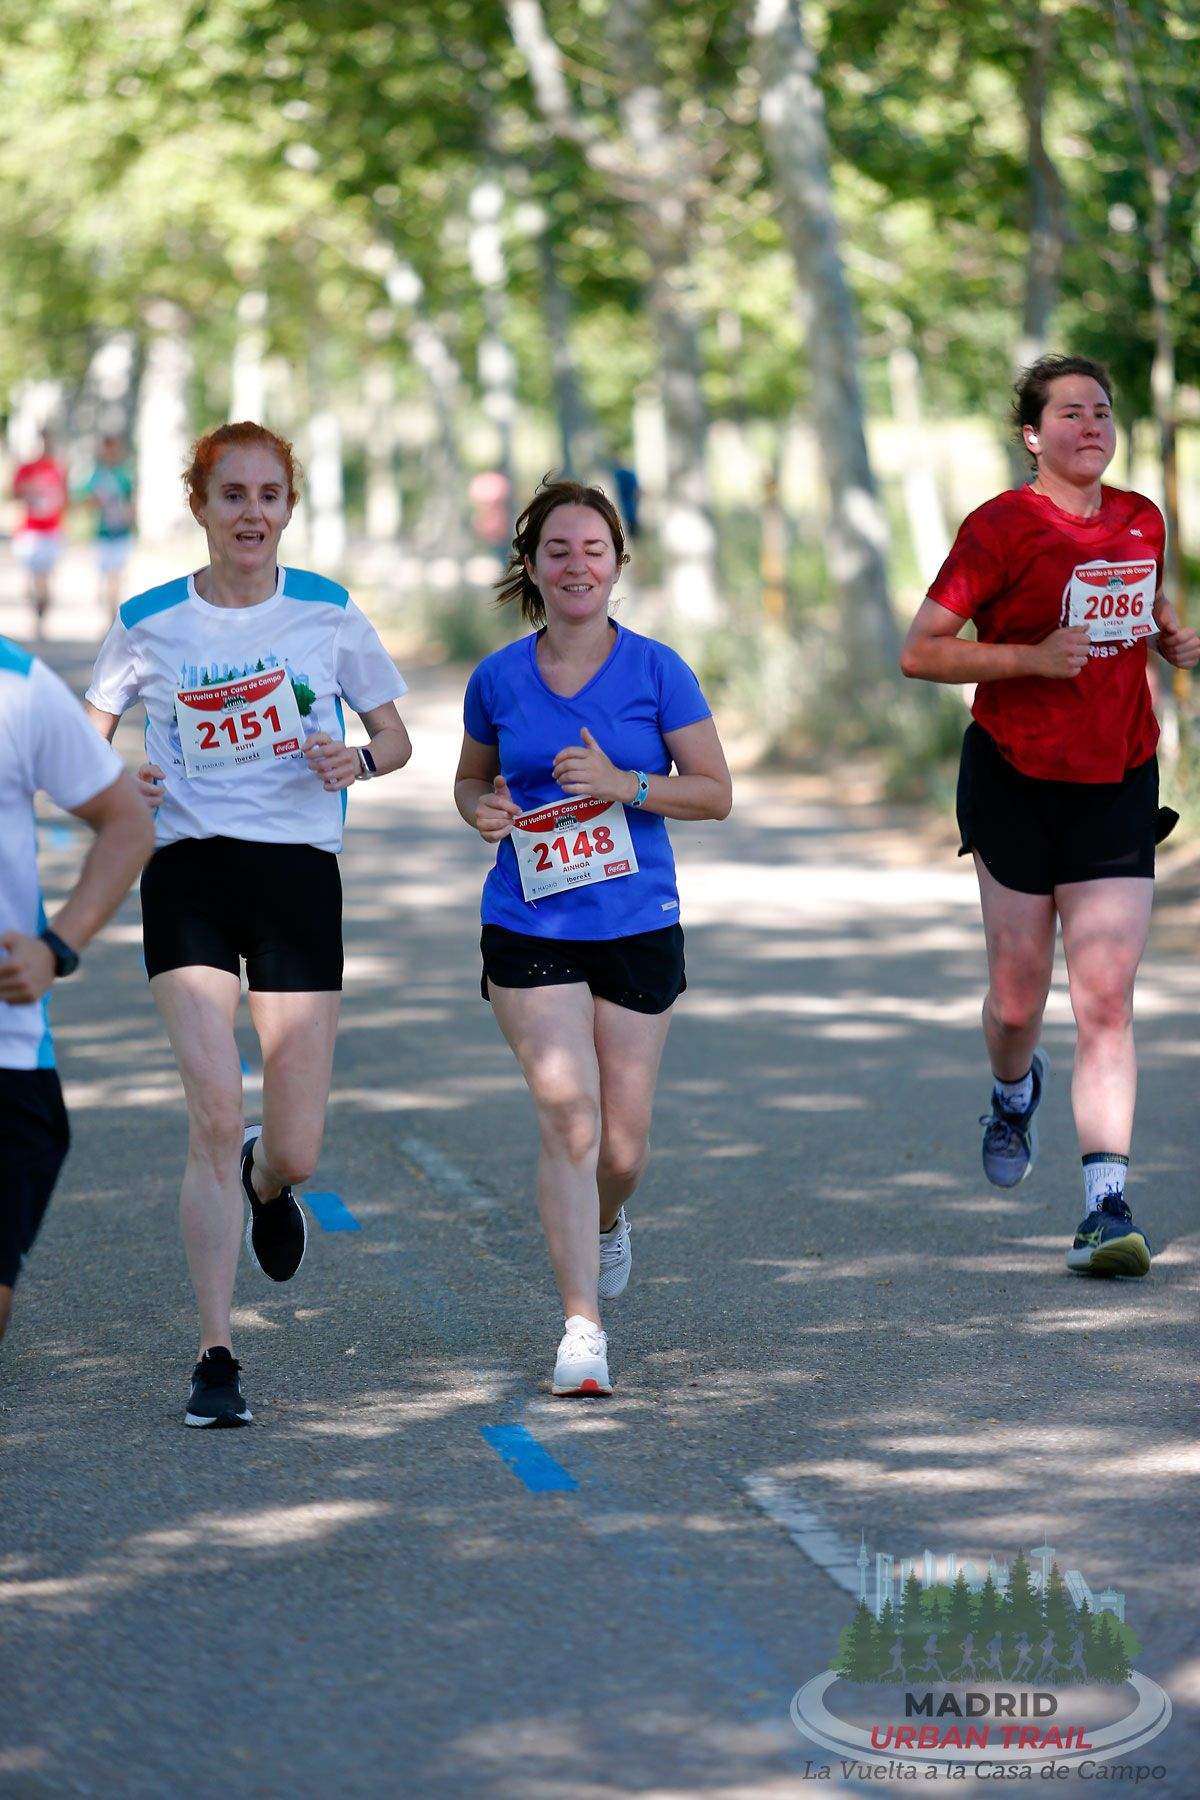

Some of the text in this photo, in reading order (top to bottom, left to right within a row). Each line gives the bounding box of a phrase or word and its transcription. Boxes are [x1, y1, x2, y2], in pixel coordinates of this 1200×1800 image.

[1084, 592, 1144, 620] 2086
[192, 692, 214, 701] Vuelta
[220, 689, 228, 697] la
[230, 686, 248, 694] Casa
[258, 675, 282, 687] Campo
[196, 705, 282, 750] 2151
[236, 742, 254, 752] RUTH
[528, 814, 546, 824] Vuelta
[561, 805, 578, 814] Casa
[532, 826, 614, 872] 2148
[563, 861, 590, 873] AINHOA
